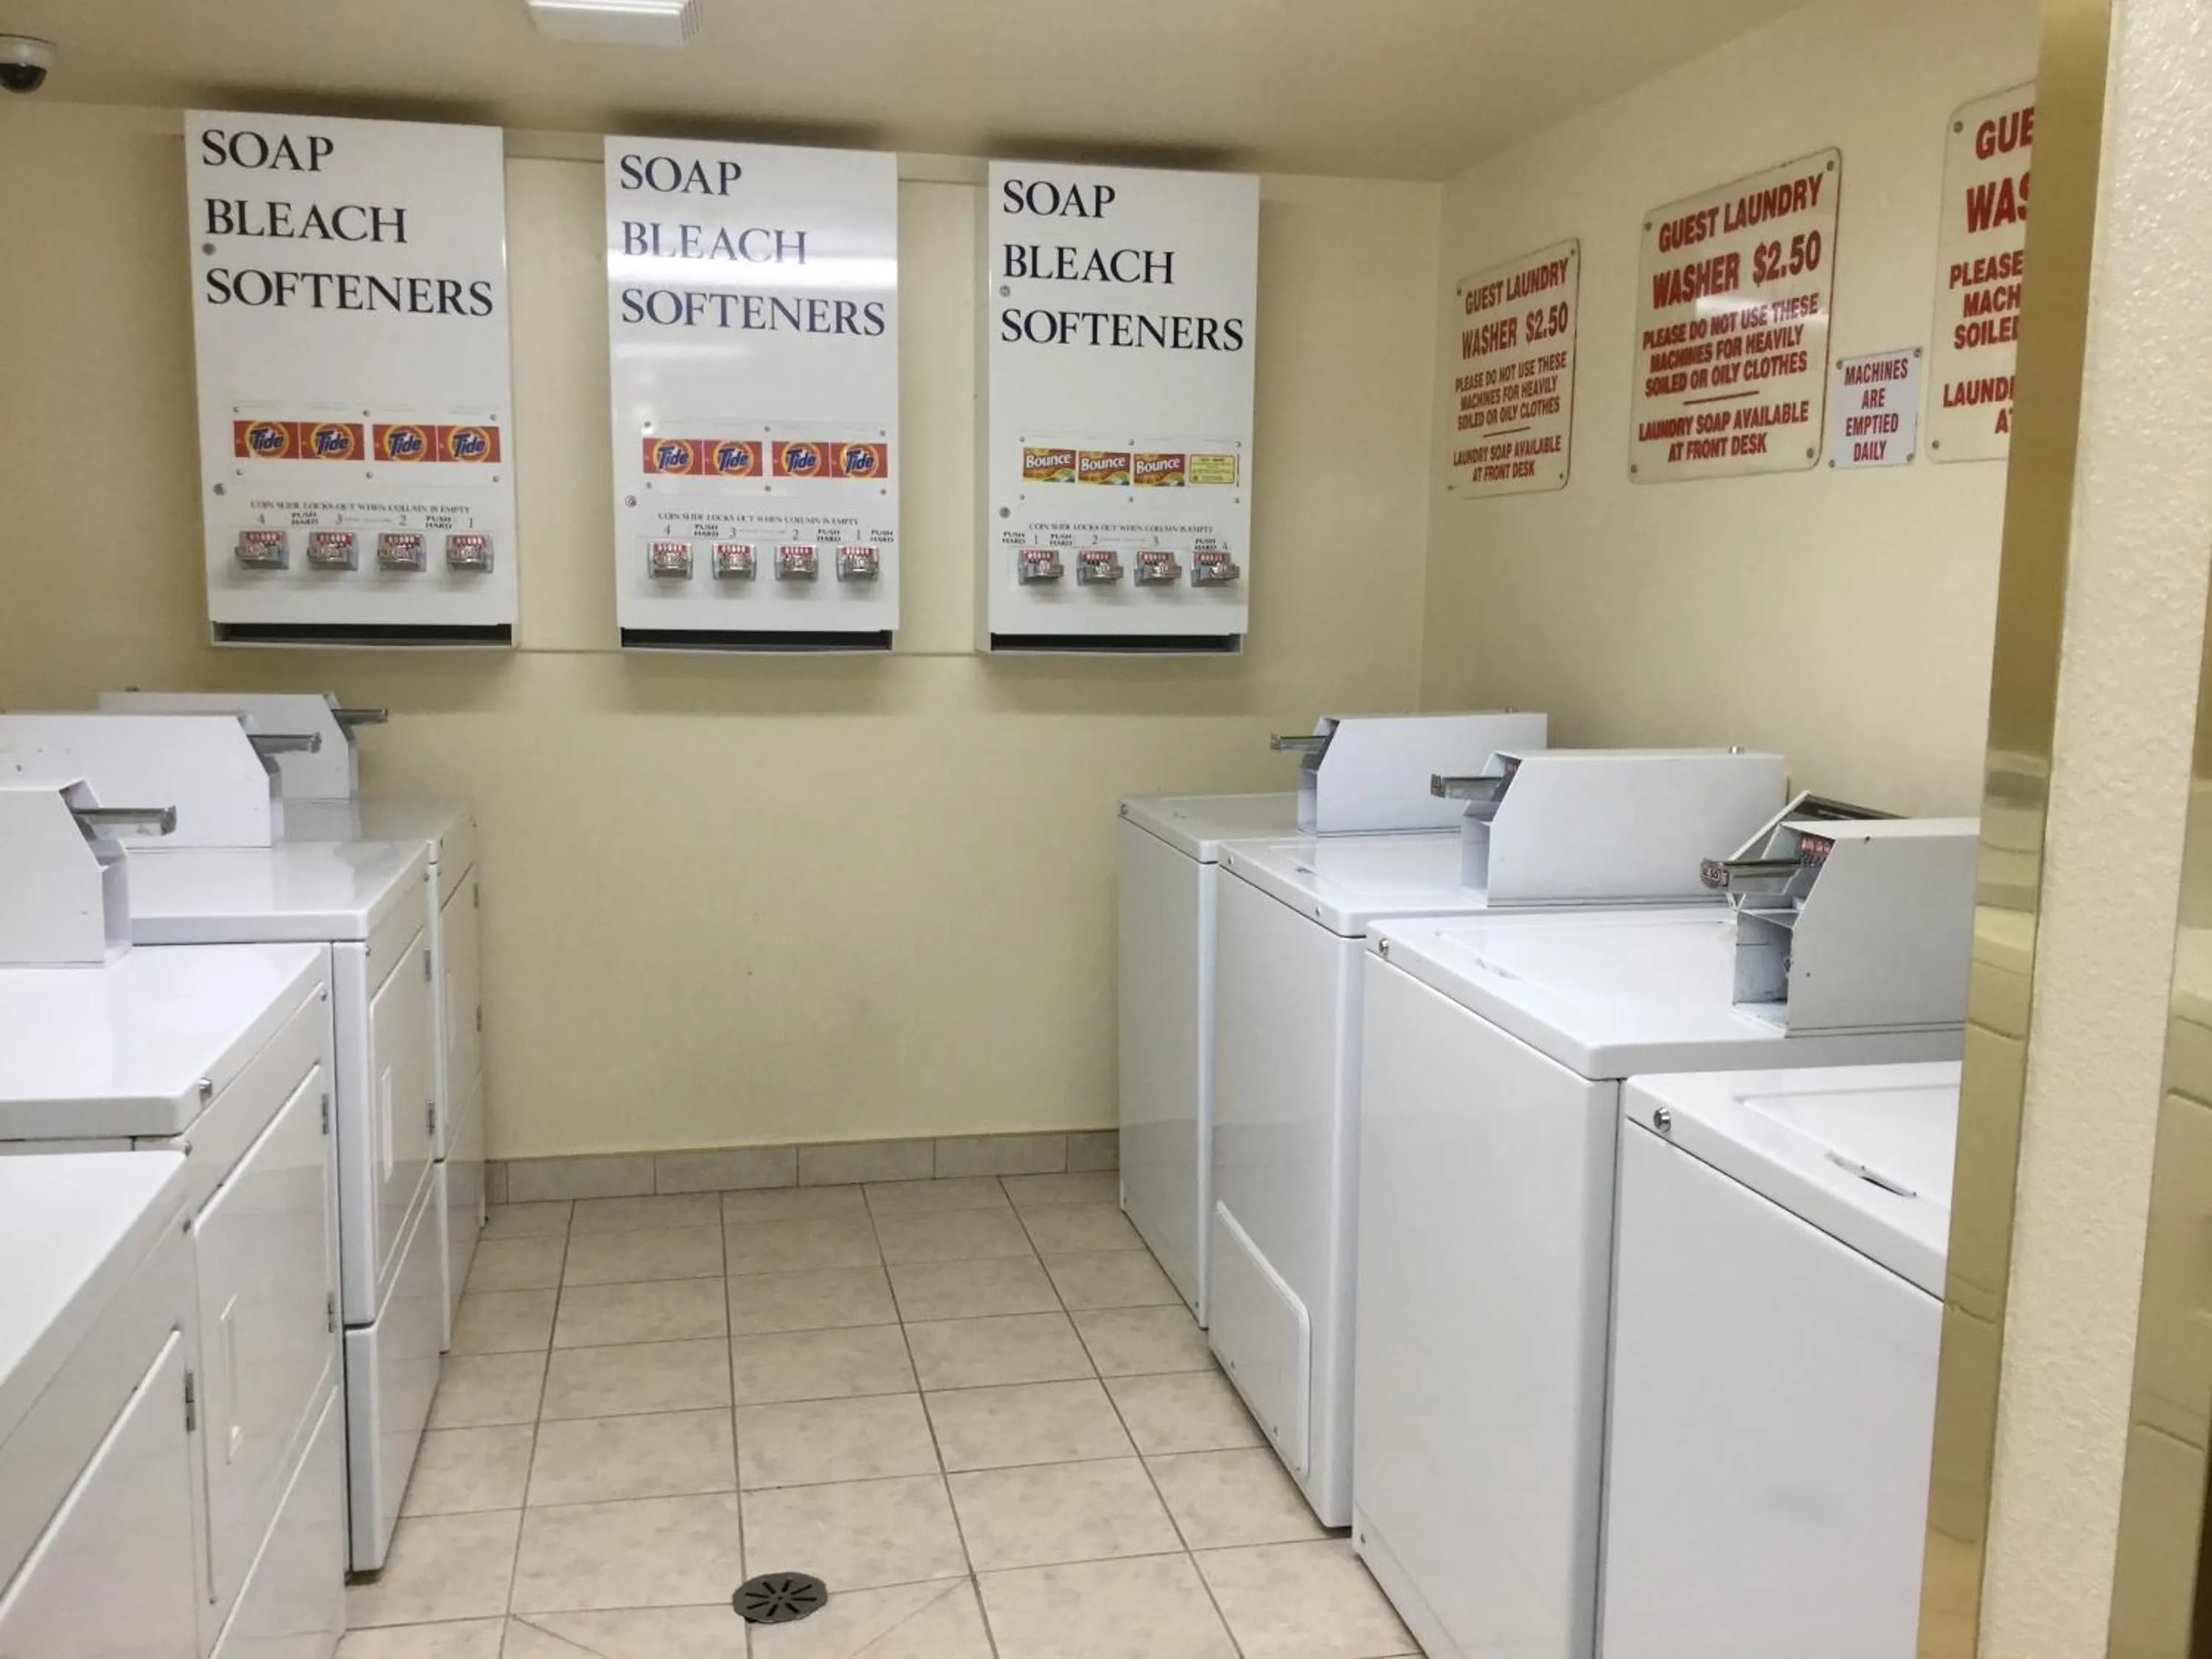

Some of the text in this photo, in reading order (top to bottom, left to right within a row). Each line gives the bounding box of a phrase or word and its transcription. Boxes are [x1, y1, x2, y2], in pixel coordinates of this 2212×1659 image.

[1975, 106, 2035, 160] GUE
[202, 129, 334, 172] SOAP
[620, 154, 742, 195] SOAP
[1003, 179, 1116, 218] SOAP
[205, 198, 408, 243] BLEACH
[1658, 172, 1824, 253] GUEST LAUNDRY
[622, 220, 806, 264] BLEACH
[1003, 244, 1175, 285] BLEACH
[1652, 229, 1822, 310] WASHER $2.50
[1950, 249, 2024, 290] PLEASE
[206, 268, 493, 316] SOFTENERS
[1465, 257, 1569, 315] GUEST LAUNDRY
[622, 288, 885, 336] SOFTENERS
[1963, 282, 2021, 318] MACH
[1001, 307, 1244, 352] SOFTENERS
[1462, 301, 1568, 360] WASHER $2.50
[1642, 293, 1819, 350] PLEASE DO NOT USE THESE
[1650, 324, 1804, 373] MACHINES FOR HEAVILY
[1455, 351, 1567, 392] PLEASE DO NOT USE THESE
[1645, 350, 1807, 397] SOILED OR OILY CLOTHES
[1844, 357, 1909, 386] MACHINES
[1461, 375, 1557, 411] MACHINES FOR HEAVILY
[1861, 388, 1885, 409] ARE
[1457, 396, 1560, 431] SOILED OR OILY CLOTHES
[1638, 400, 1809, 442] LAUNDRY SOAP AVAILABLE
[1846, 412, 1899, 437] EMPTIED
[1994, 408, 2014, 434] A
[250, 428, 284, 451] Tide
[316, 430, 351, 455] Tide
[389, 432, 422, 456] Tide
[453, 434, 484, 457] Tide
[1453, 434, 1562, 466] LAUNDRY SOAP AVAILABLE
[1668, 432, 1767, 462] AT FRONT DESK
[1853, 440, 1887, 462] DAILY
[658, 445, 689, 469] Tide
[718, 448, 749, 470] Tide
[786, 448, 817, 473] Tide
[845, 450, 874, 473] Tide
[1026, 453, 1071, 468] Bounce
[1081, 456, 1126, 472] Bounce
[1136, 457, 1180, 474] Bounce
[1472, 459, 1535, 482] AT FRONT DESK
[257, 513, 265, 524] 4
[335, 514, 343, 524] 3
[398, 515, 407, 526] 2
[469, 518, 473, 528] 1
[664, 524, 670, 535] 4
[729, 527, 737, 538] 3
[792, 529, 799, 540] 2
[857, 529, 860, 540] 1
[1034, 534, 1039, 544] 1
[1091, 534, 1099, 545] 2
[1152, 535, 1160, 546] 3
